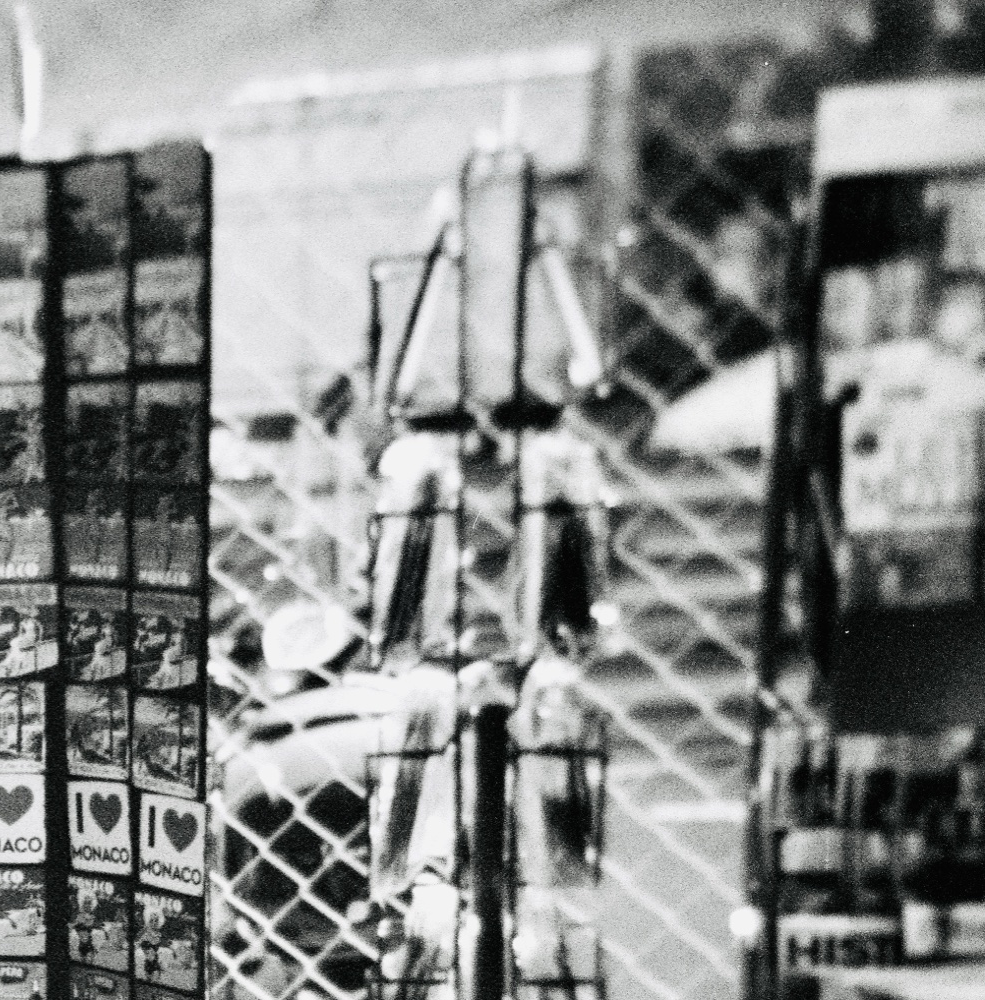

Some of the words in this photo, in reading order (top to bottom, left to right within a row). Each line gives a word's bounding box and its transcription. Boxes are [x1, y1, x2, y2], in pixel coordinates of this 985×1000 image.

[75, 792, 84, 833] I
[148, 805, 156, 848] I
[71, 844, 130, 864] MONACO
[139, 859, 202, 885] MONACO
